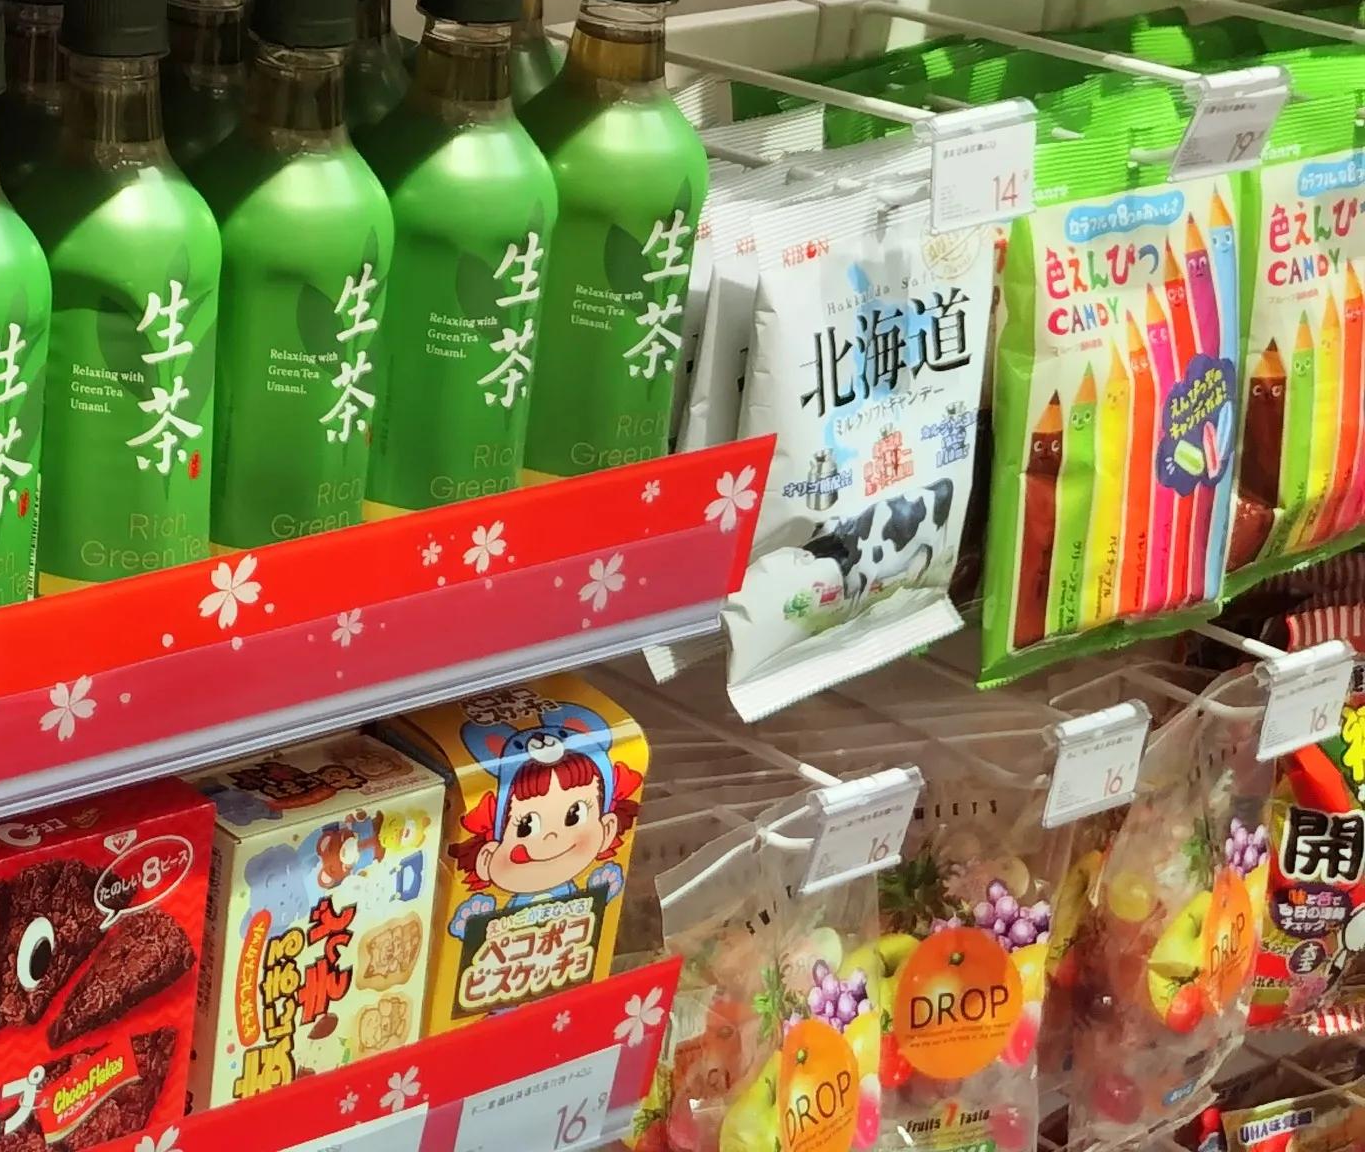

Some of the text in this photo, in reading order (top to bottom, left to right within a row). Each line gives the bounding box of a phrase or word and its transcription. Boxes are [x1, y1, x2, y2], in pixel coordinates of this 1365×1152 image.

[1043, 243, 1161, 300] 色えんぴつ
[1267, 248, 1341, 287] CANDY
[621, 209, 691, 379] 生茶
[1047, 297, 1121, 336] CANDY
[477, 232, 541, 408] 生茶
[72, 364, 145, 384] Relaxing with
[268, 365, 320, 380] Green Tea
[269, 348, 339, 364] Relaxing with
[318, 263, 379, 443] 生茶
[799, 288, 972, 418] 北海道
[71, 382, 124, 398] Green Tea
[125, 279, 203, 476] 生茶
[267, 381, 308, 395] Umami.
[70, 398, 112, 414] Umami.
[129, 512, 188, 540] Rich
[81, 540, 173, 571] Green
[1281, 805, 1365, 885] 開
[98, 851, 188, 902] たのしい8ピース
[478, 916, 593, 964] ペコポコ
[463, 946, 592, 1003] ビスケッチョ
[909, 983, 1010, 1030] DROP
[553, 1091, 609, 1149] 16.9
[784, 1069, 852, 1148] DROP
[906, 1115, 942, 1133] Fruits
